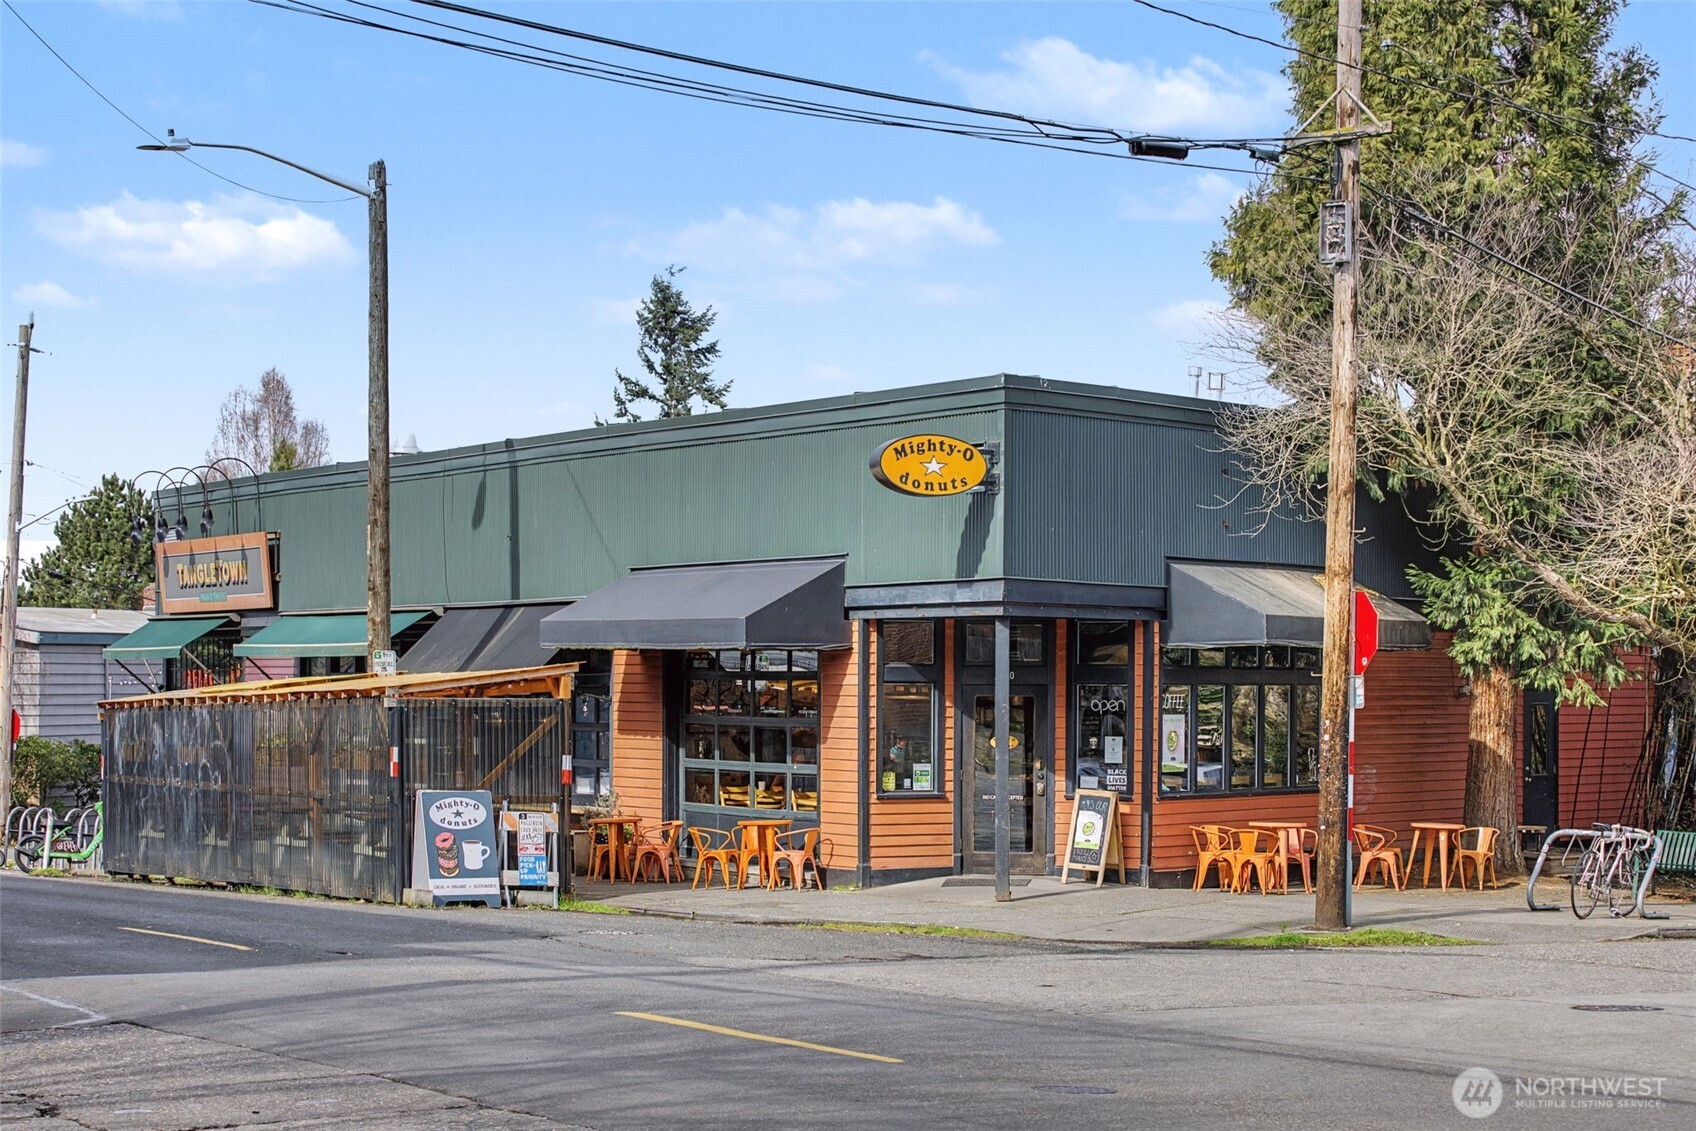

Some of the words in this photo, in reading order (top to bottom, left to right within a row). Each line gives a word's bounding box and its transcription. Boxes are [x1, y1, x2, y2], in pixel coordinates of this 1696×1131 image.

[893, 438, 975, 462] Mighty-O
[899, 472, 968, 491] donuts
[1091, 699, 1126, 715] open
[435, 799, 480, 813] Mighty-O
[440, 817, 478, 827] donuts
